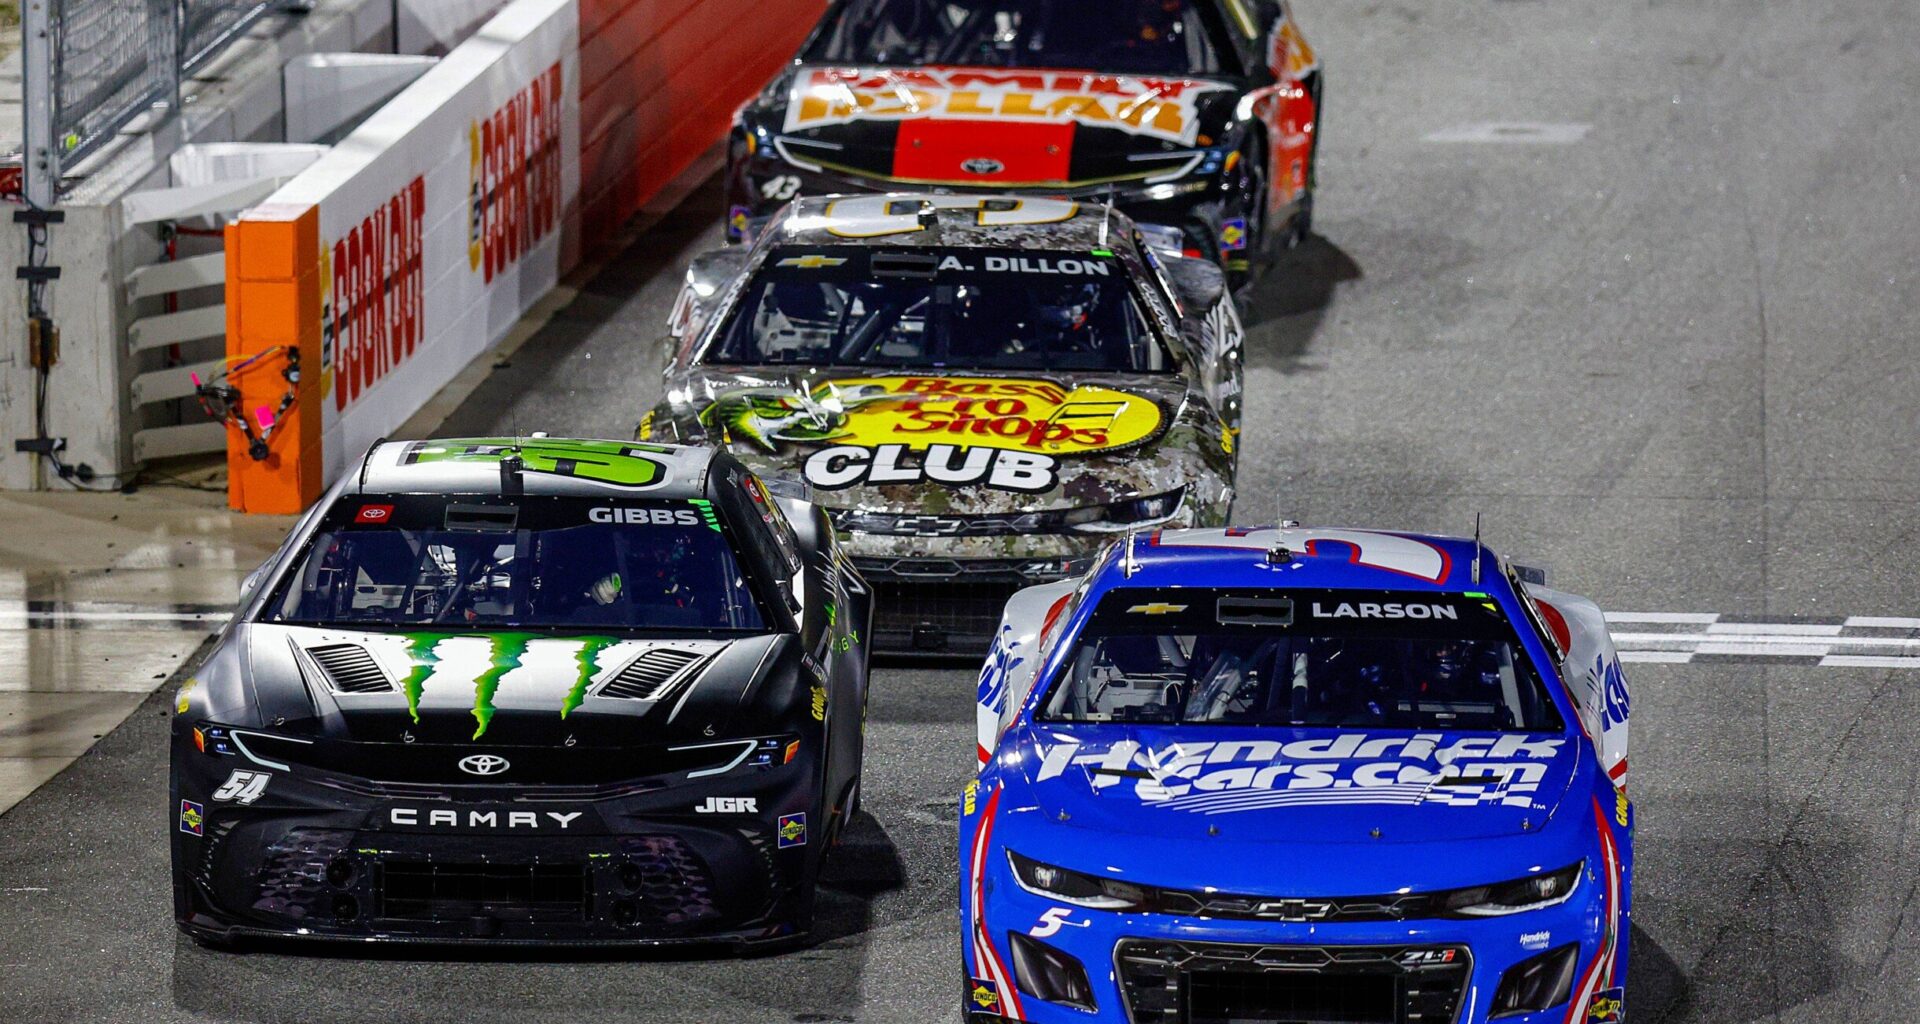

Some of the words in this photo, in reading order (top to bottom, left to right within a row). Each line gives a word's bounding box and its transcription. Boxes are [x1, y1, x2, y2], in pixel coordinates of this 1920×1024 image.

[762, 175, 801, 199] 43
[938, 256, 974, 271] A.
[984, 256, 1110, 275] DILLON
[899, 392, 1028, 416] Pro
[893, 412, 1108, 447] Shops
[805, 444, 1055, 489] CLUB
[589, 507, 699, 525] GIBBS
[1312, 602, 1458, 620] LARSON
[1036, 734, 1566, 788] Hendrick
[213, 769, 271, 805] 54
[695, 797, 759, 813] JGR
[391, 808, 583, 828] CAMRY
[1029, 907, 1073, 937] 5
[1400, 949, 1456, 969] ZL1
